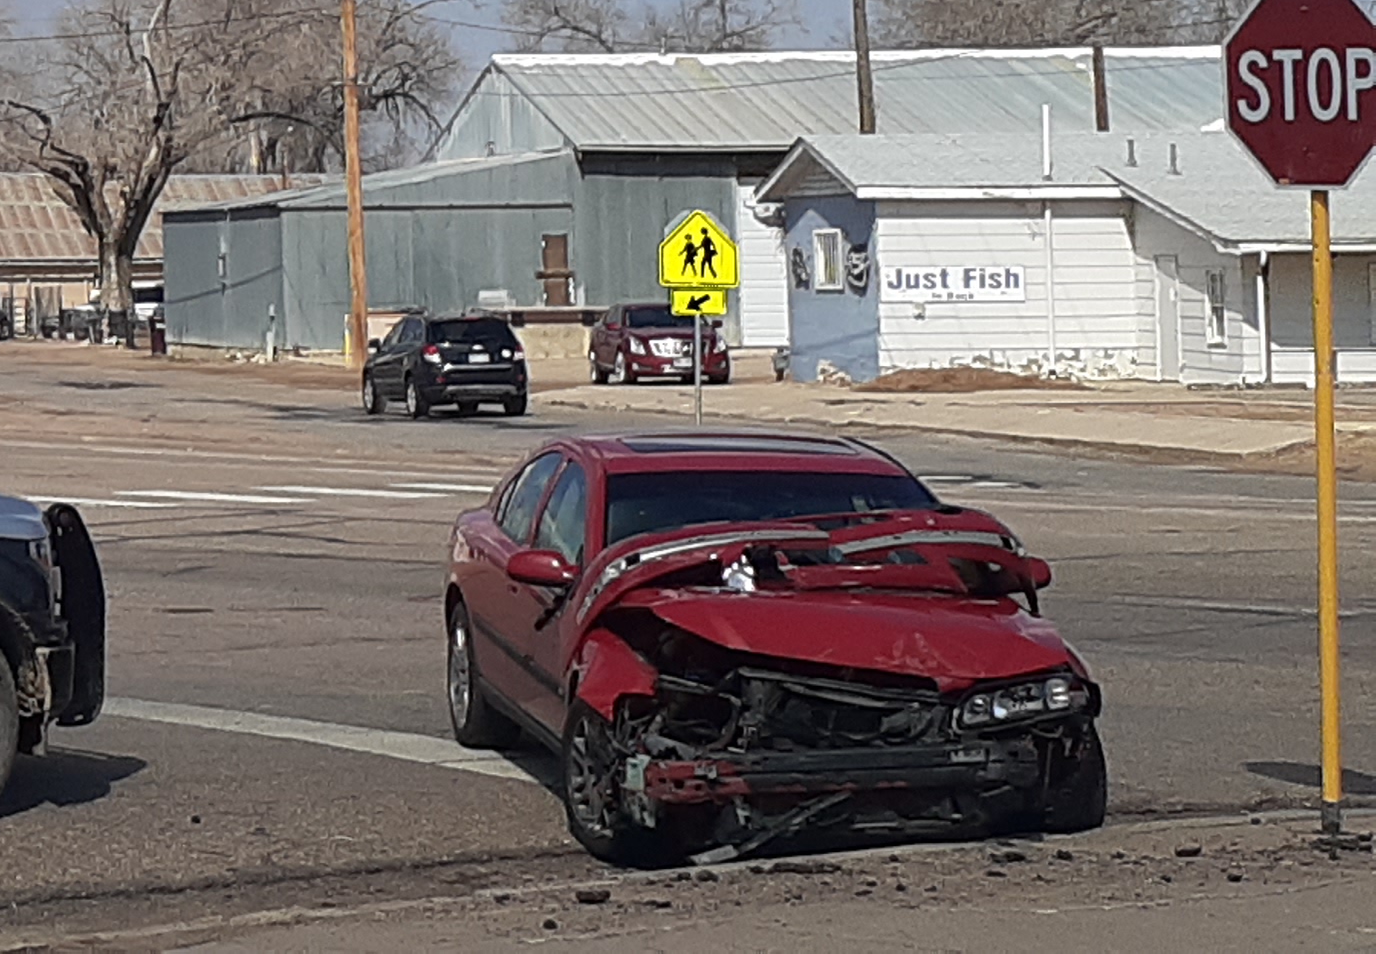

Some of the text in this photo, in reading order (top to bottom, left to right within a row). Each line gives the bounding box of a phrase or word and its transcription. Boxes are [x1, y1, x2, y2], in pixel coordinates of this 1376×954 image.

[1237, 48, 1376, 123] STOP
[887, 267, 1019, 289] Just Fish
